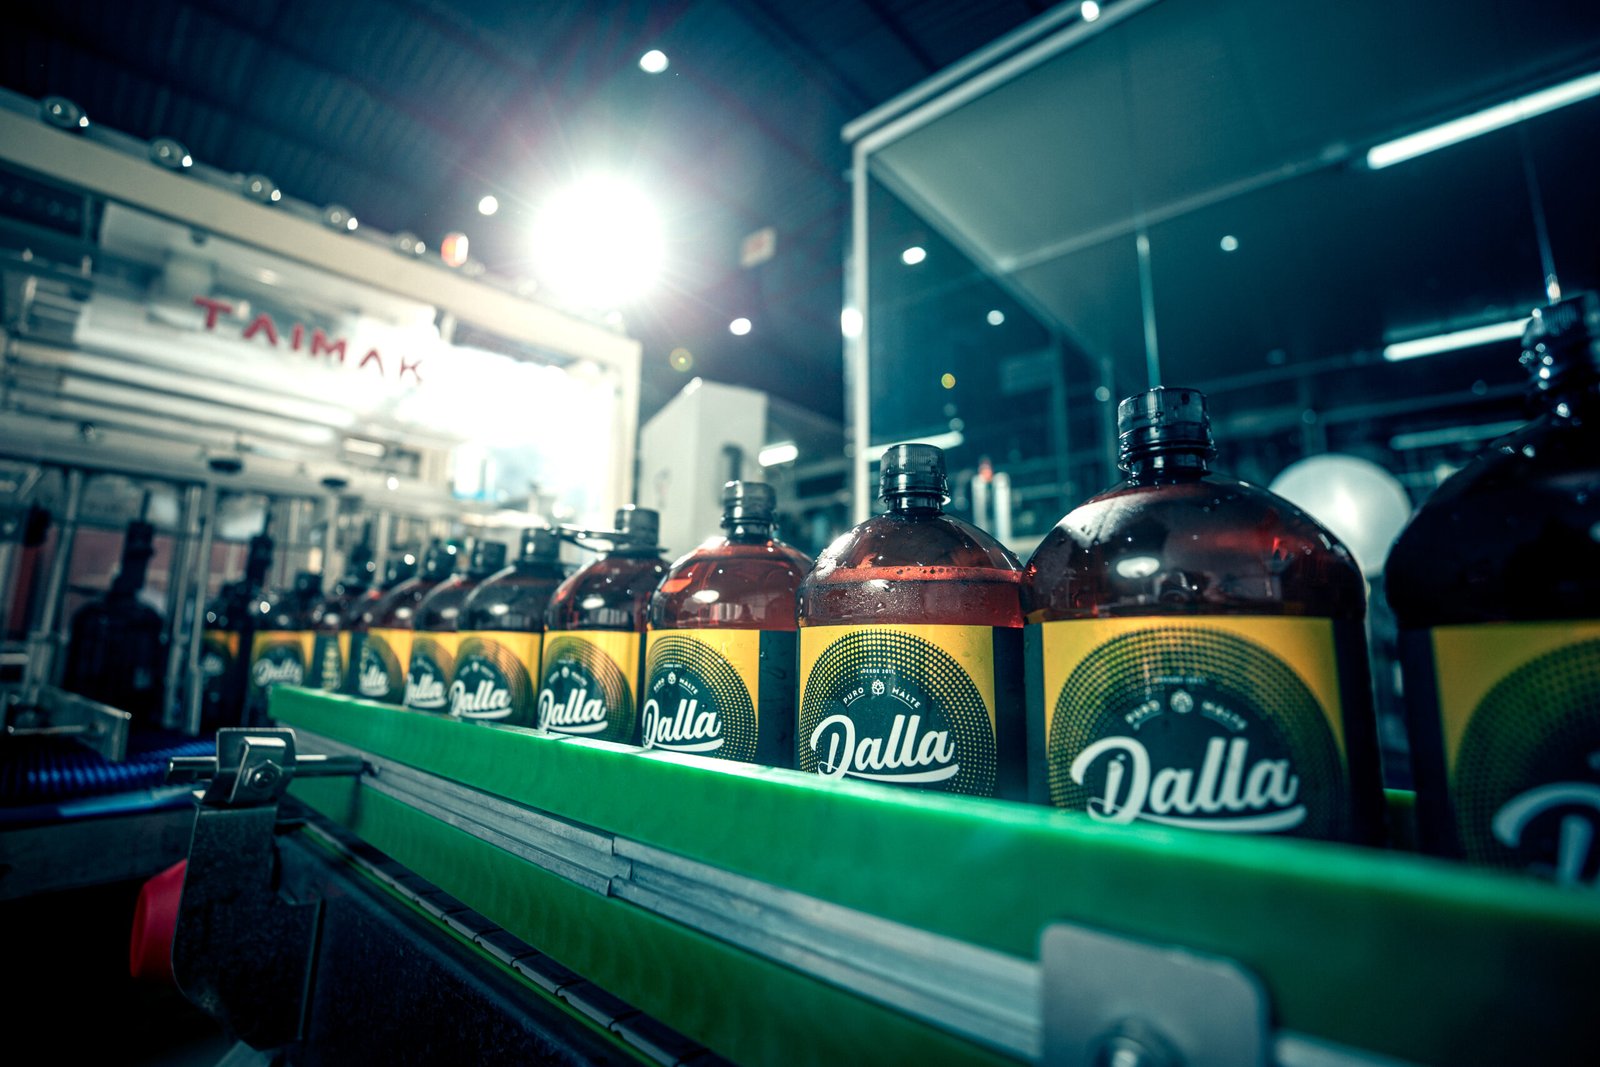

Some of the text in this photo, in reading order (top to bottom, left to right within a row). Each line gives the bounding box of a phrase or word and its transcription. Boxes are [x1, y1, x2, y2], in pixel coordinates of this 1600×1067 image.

[193, 296, 423, 384] TAIMAK
[448, 680, 513, 719] Dalla
[538, 688, 609, 734] Dalla
[843, 687, 921, 709] PURO MALTE
[642, 699, 725, 752] Dalla
[810, 714, 960, 783] Dalla
[1070, 736, 1307, 833] Dalla
